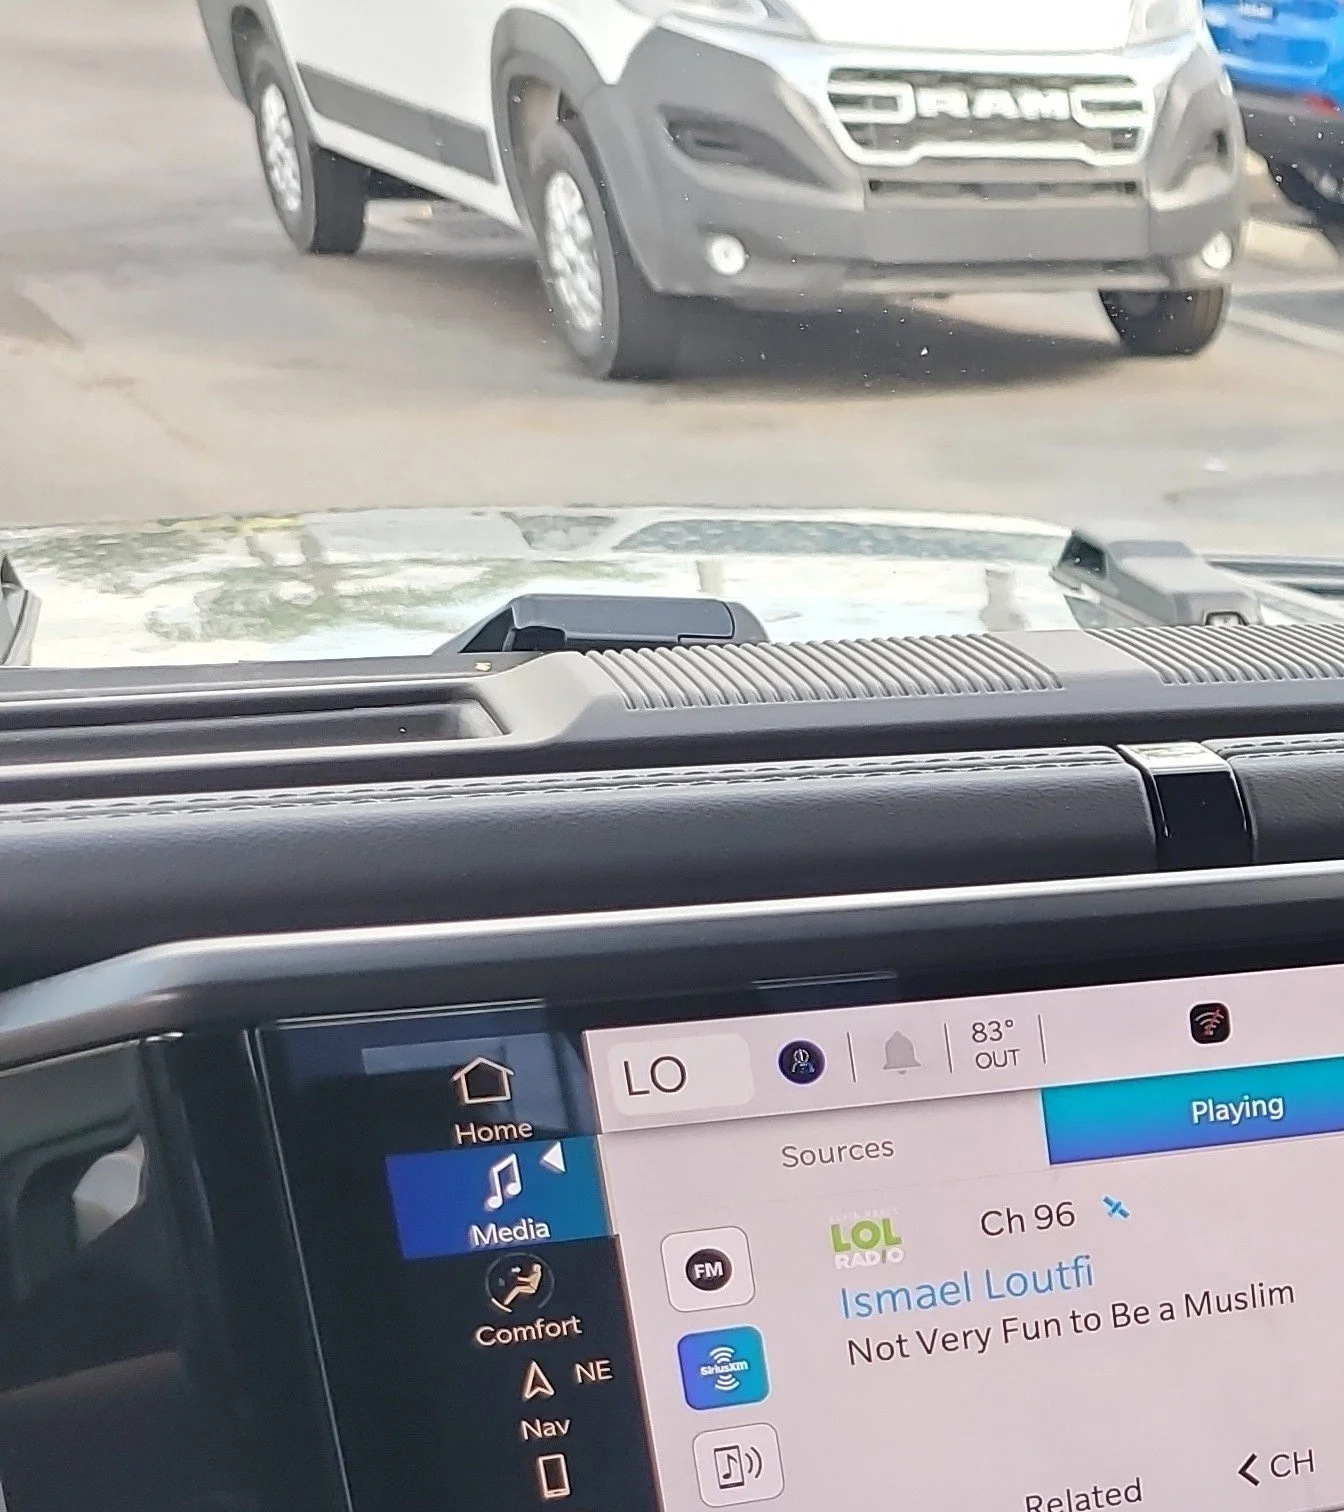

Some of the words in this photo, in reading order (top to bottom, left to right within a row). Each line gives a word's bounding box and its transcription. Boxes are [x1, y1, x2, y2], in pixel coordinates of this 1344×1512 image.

[916, 86, 1071, 121] RAM
[974, 1047, 1022, 1071] OUT
[623, 1055, 687, 1097] LO
[1191, 1094, 1285, 1125] Playing
[454, 1120, 533, 1146] Home
[781, 1136, 896, 1169] Sources
[470, 1218, 551, 1248] Media
[830, 1217, 903, 1253] LOL
[980, 1205, 1024, 1238] Ch
[1034, 1201, 1077, 1232] 96
[693, 1261, 725, 1280] FM
[839, 1270, 973, 1320] Ismael
[985, 1253, 1095, 1301] Loutfi
[475, 1314, 583, 1348] Comfort
[847, 1332, 910, 1367] Not
[916, 1322, 991, 1364] Very
[1002, 1315, 1062, 1344] Fun
[1069, 1306, 1102, 1334] to
[1111, 1299, 1150, 1329] Be
[1159, 1302, 1176, 1322] a
[1184, 1280, 1296, 1319] Muslim
[575, 1360, 614, 1384] NE
[521, 1416, 571, 1441] Nav
[1270, 1450, 1315, 1479] CH
